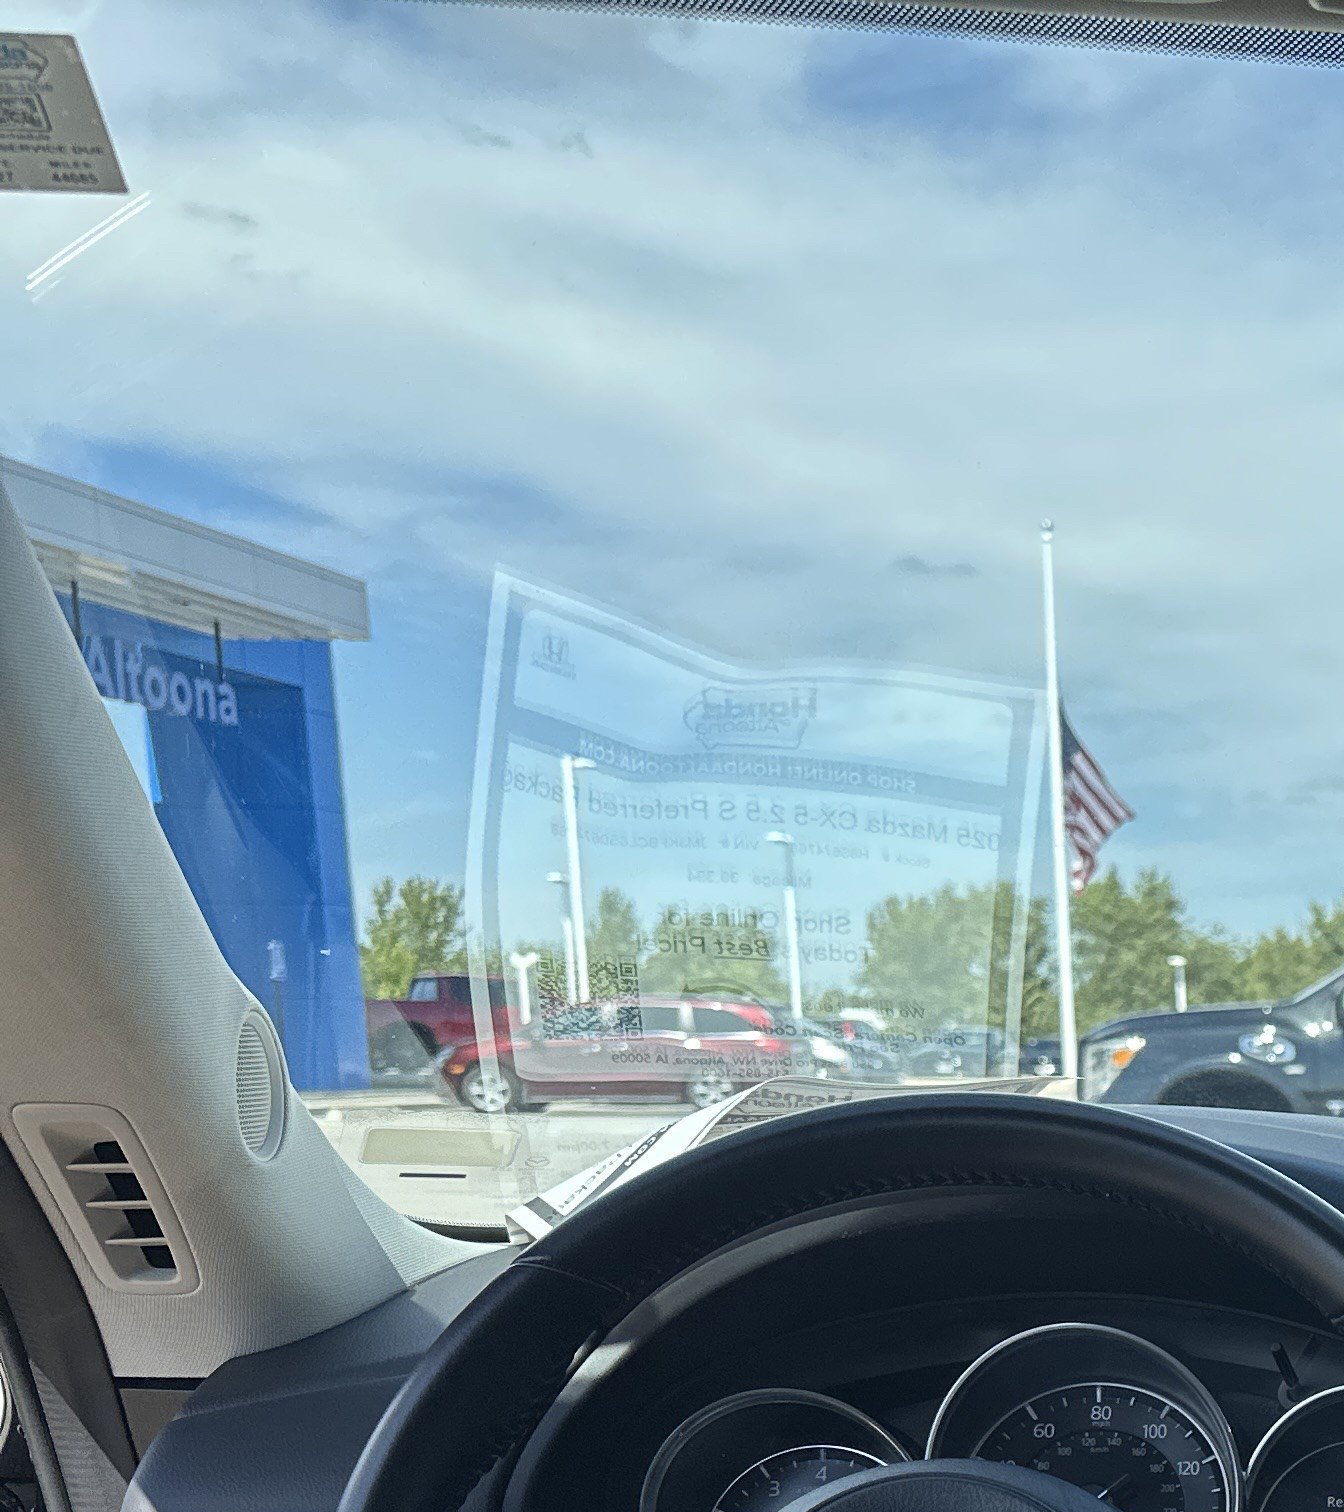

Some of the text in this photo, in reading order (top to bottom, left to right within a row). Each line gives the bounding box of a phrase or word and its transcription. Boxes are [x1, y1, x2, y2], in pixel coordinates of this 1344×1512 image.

[84, 634, 238, 727] Altoona
[1091, 1406, 1112, 1421] 80
[1033, 1423, 1055, 1439] 60
[1142, 1424, 1167, 1439] 100
[815, 1466, 828, 1481] 4
[1178, 1461, 1200, 1476] 120
[768, 1480, 781, 1498] 3
